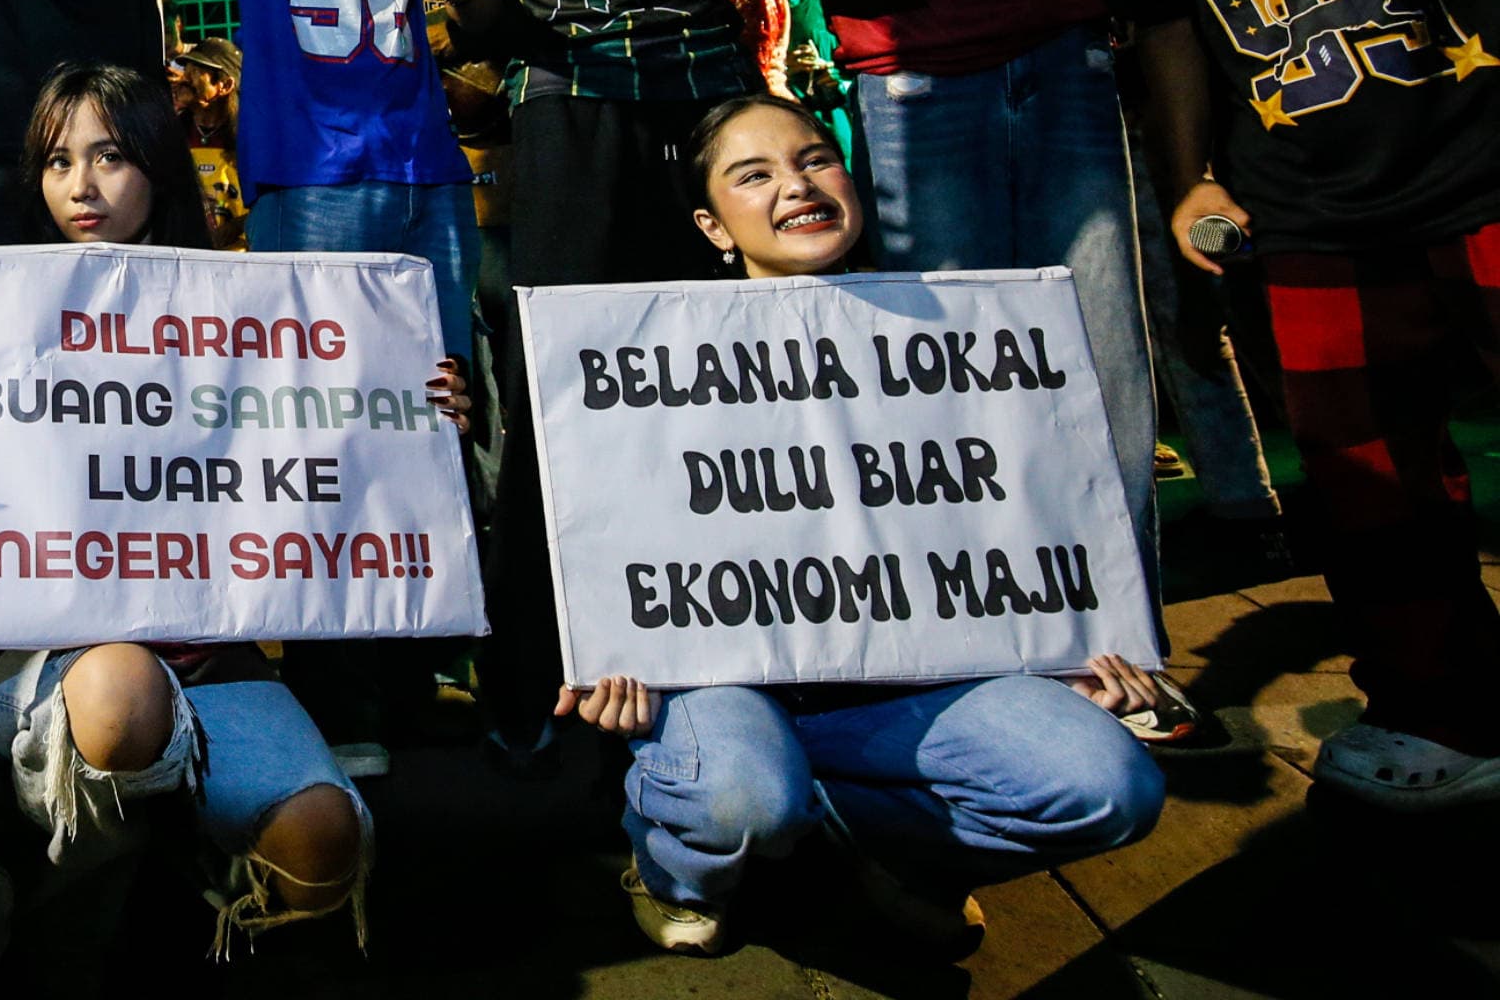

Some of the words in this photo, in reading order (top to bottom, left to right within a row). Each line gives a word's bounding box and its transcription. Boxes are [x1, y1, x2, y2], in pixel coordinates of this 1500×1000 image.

[60, 309, 346, 361] DILARANG
[579, 338, 859, 410] BELANJA
[872, 327, 1066, 397] LOKAL
[190, 384, 439, 433] SAMPAH
[88, 454, 243, 502] LUAR
[262, 457, 341, 502] KE
[683, 445, 834, 515] DULU
[851, 437, 1006, 507] BIAR
[229, 532, 434, 580] SAYA!!!
[626, 553, 911, 628] EKONOMI
[927, 543, 1099, 618] MAJU
